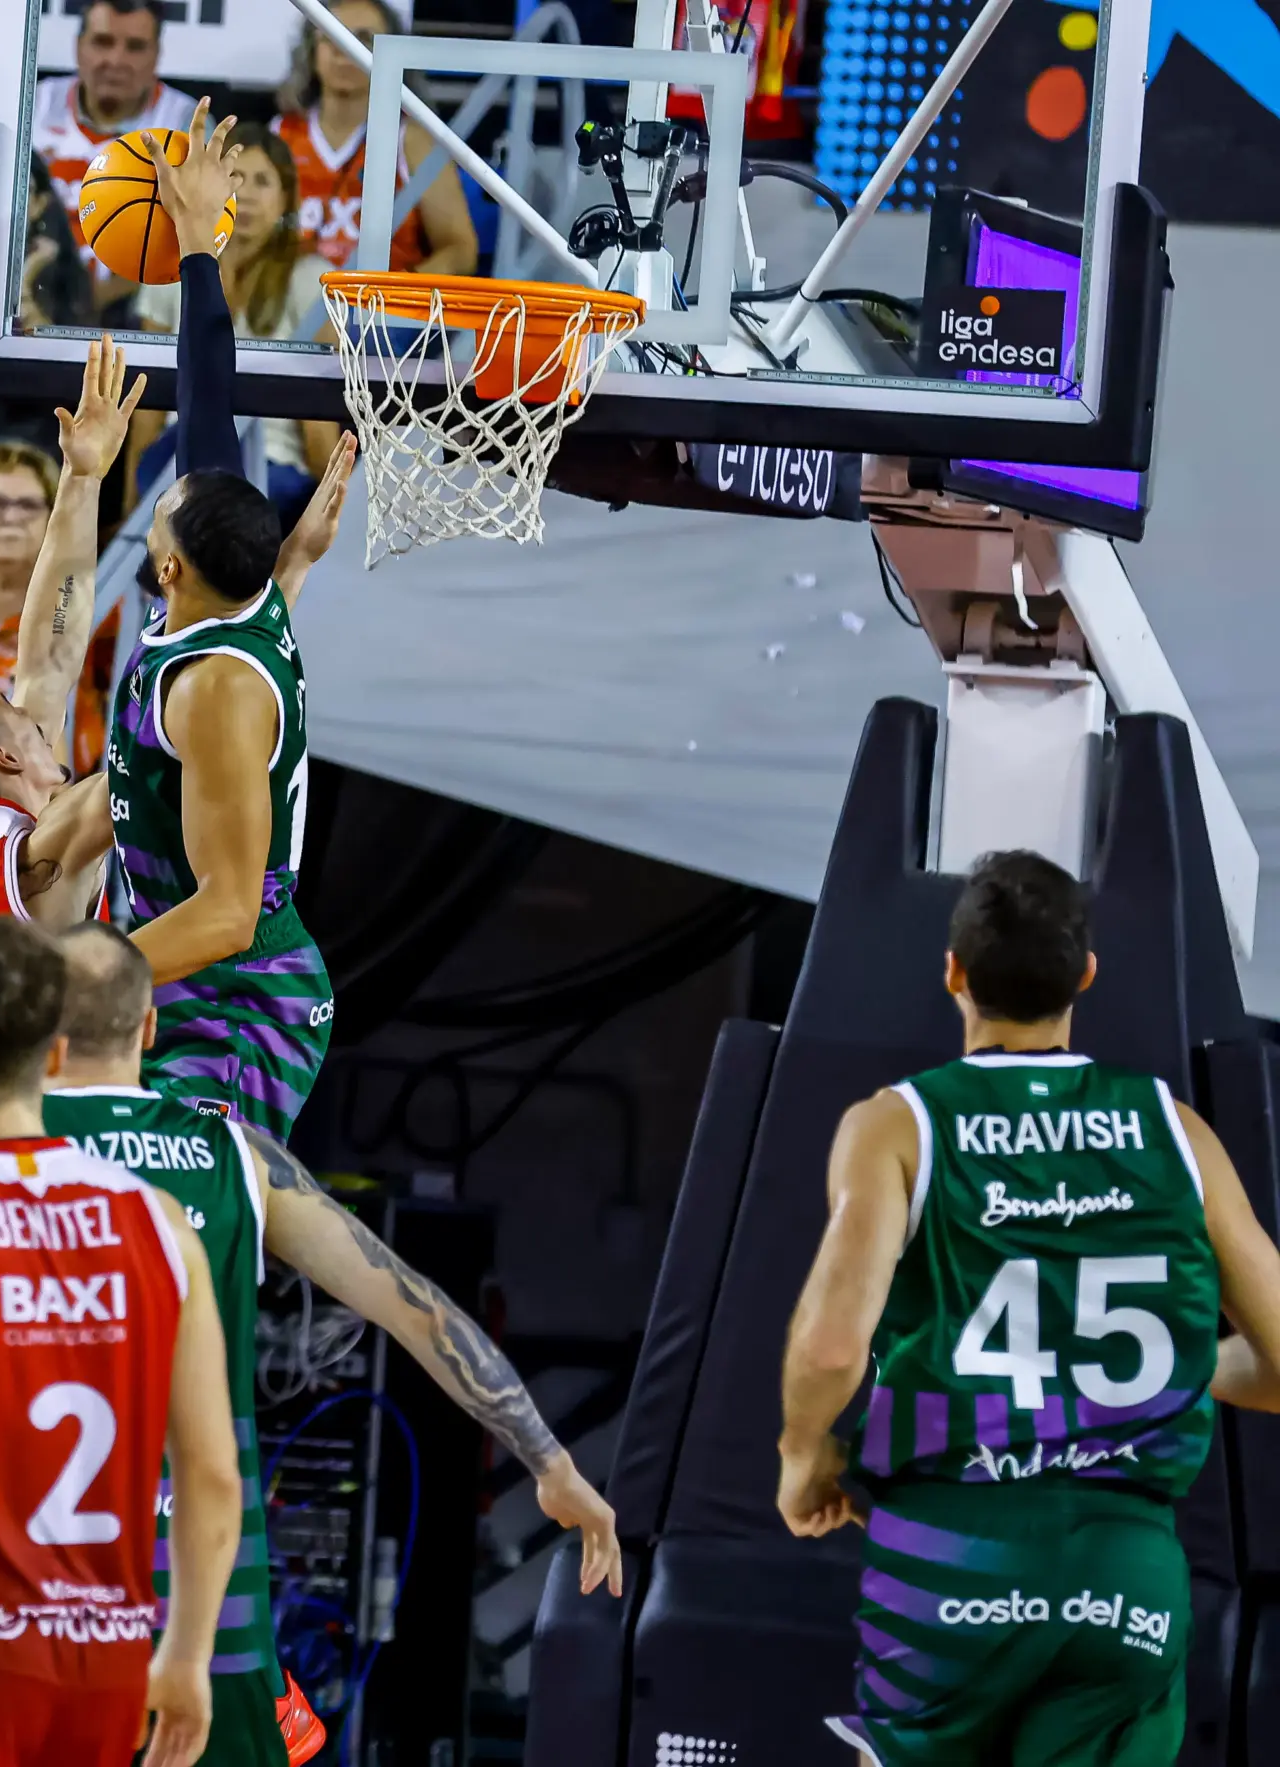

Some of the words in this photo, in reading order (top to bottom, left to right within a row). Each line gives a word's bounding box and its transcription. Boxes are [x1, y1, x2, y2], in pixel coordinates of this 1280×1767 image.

[939, 308, 993, 339] liga
[938, 338, 1056, 368] endesa
[66, 1131, 216, 1171] AZDEIKIS
[955, 1109, 1145, 1155] KRAVISH
[0, 1272, 127, 1323] BAXI
[951, 1255, 1175, 1411] 45
[26, 1381, 121, 1546] 2
[937, 1589, 1050, 1625] costa
[1061, 1589, 1124, 1629] del
[1126, 1606, 1171, 1644] sol
